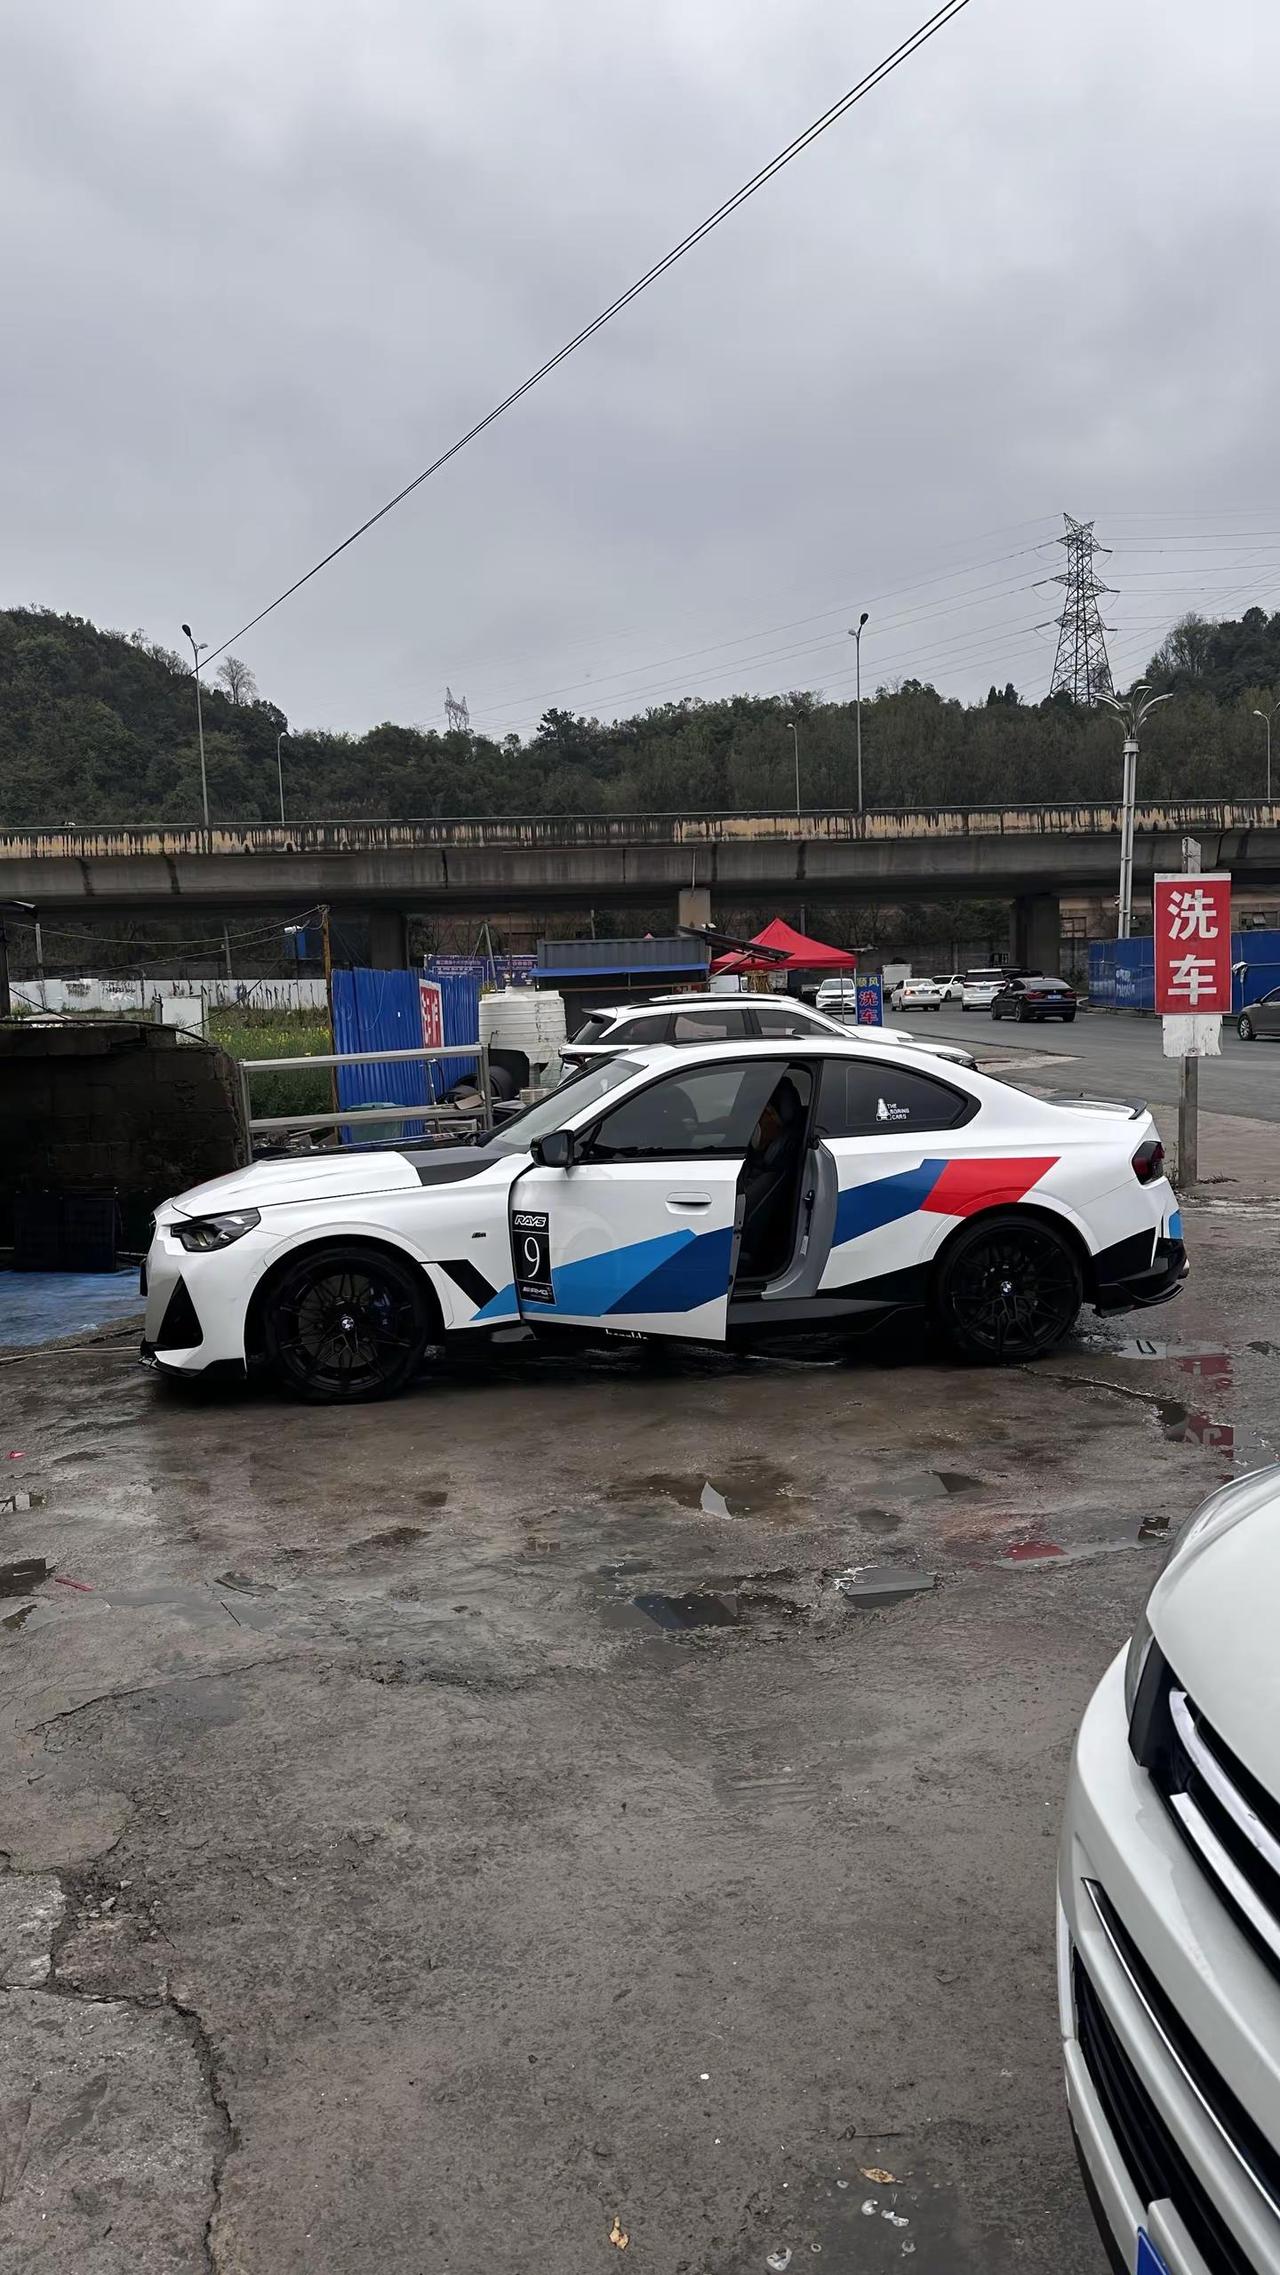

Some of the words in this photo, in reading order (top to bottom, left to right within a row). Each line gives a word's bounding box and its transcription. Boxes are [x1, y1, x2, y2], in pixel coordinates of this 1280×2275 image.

[1167, 889, 1218, 1006] 洗车
[859, 991, 878, 1024] 洗车
[515, 1215, 546, 1227] RAYS
[524, 1236, 540, 1278] 9
